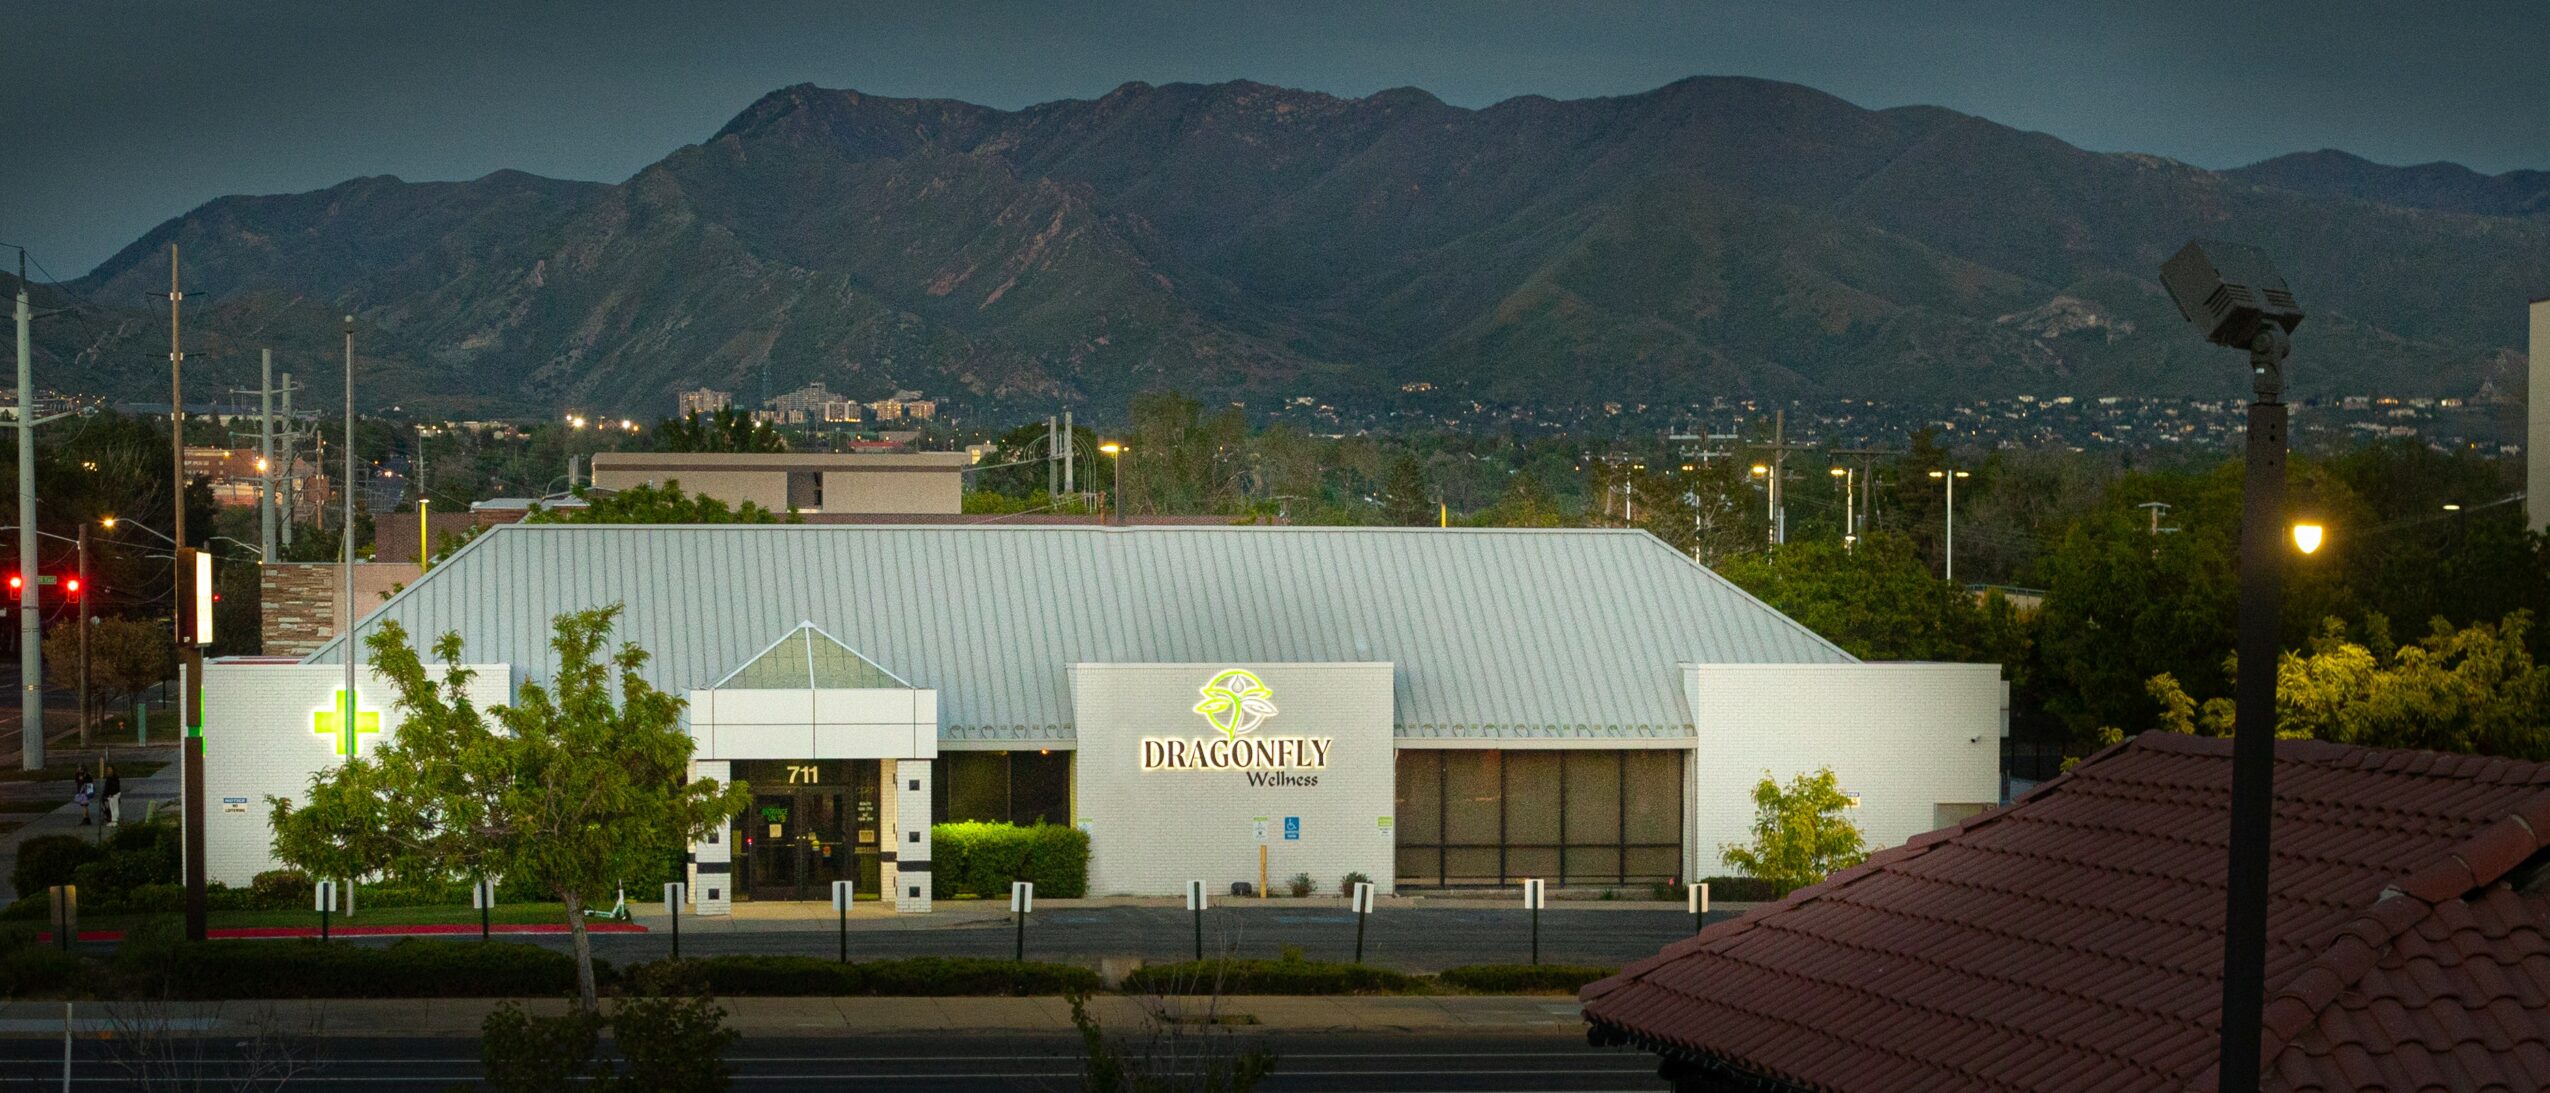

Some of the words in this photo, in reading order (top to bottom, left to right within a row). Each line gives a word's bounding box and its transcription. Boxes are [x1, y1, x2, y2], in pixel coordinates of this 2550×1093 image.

[1144, 738, 1332, 769] DRAGONFLY
[787, 766, 818, 783] 711
[1246, 770, 1318, 787] Wellness
